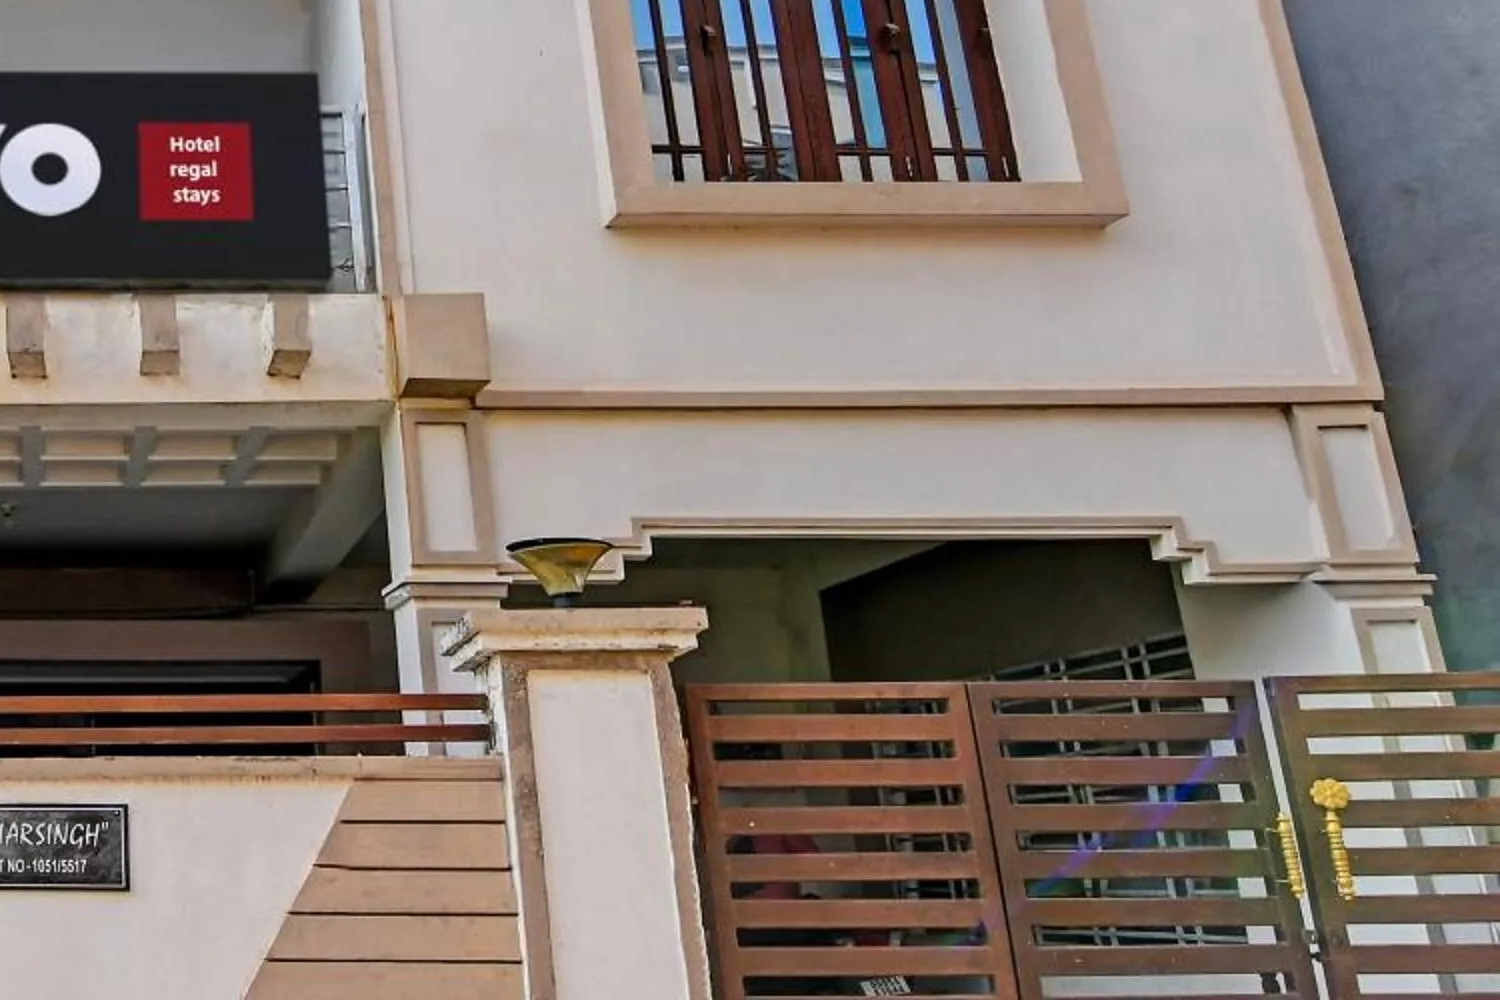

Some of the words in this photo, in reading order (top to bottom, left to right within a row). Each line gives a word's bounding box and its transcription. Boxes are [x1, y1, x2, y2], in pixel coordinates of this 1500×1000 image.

[169, 135, 220, 152] Hotel
[169, 160, 218, 181] regal
[172, 187, 221, 206] stays
